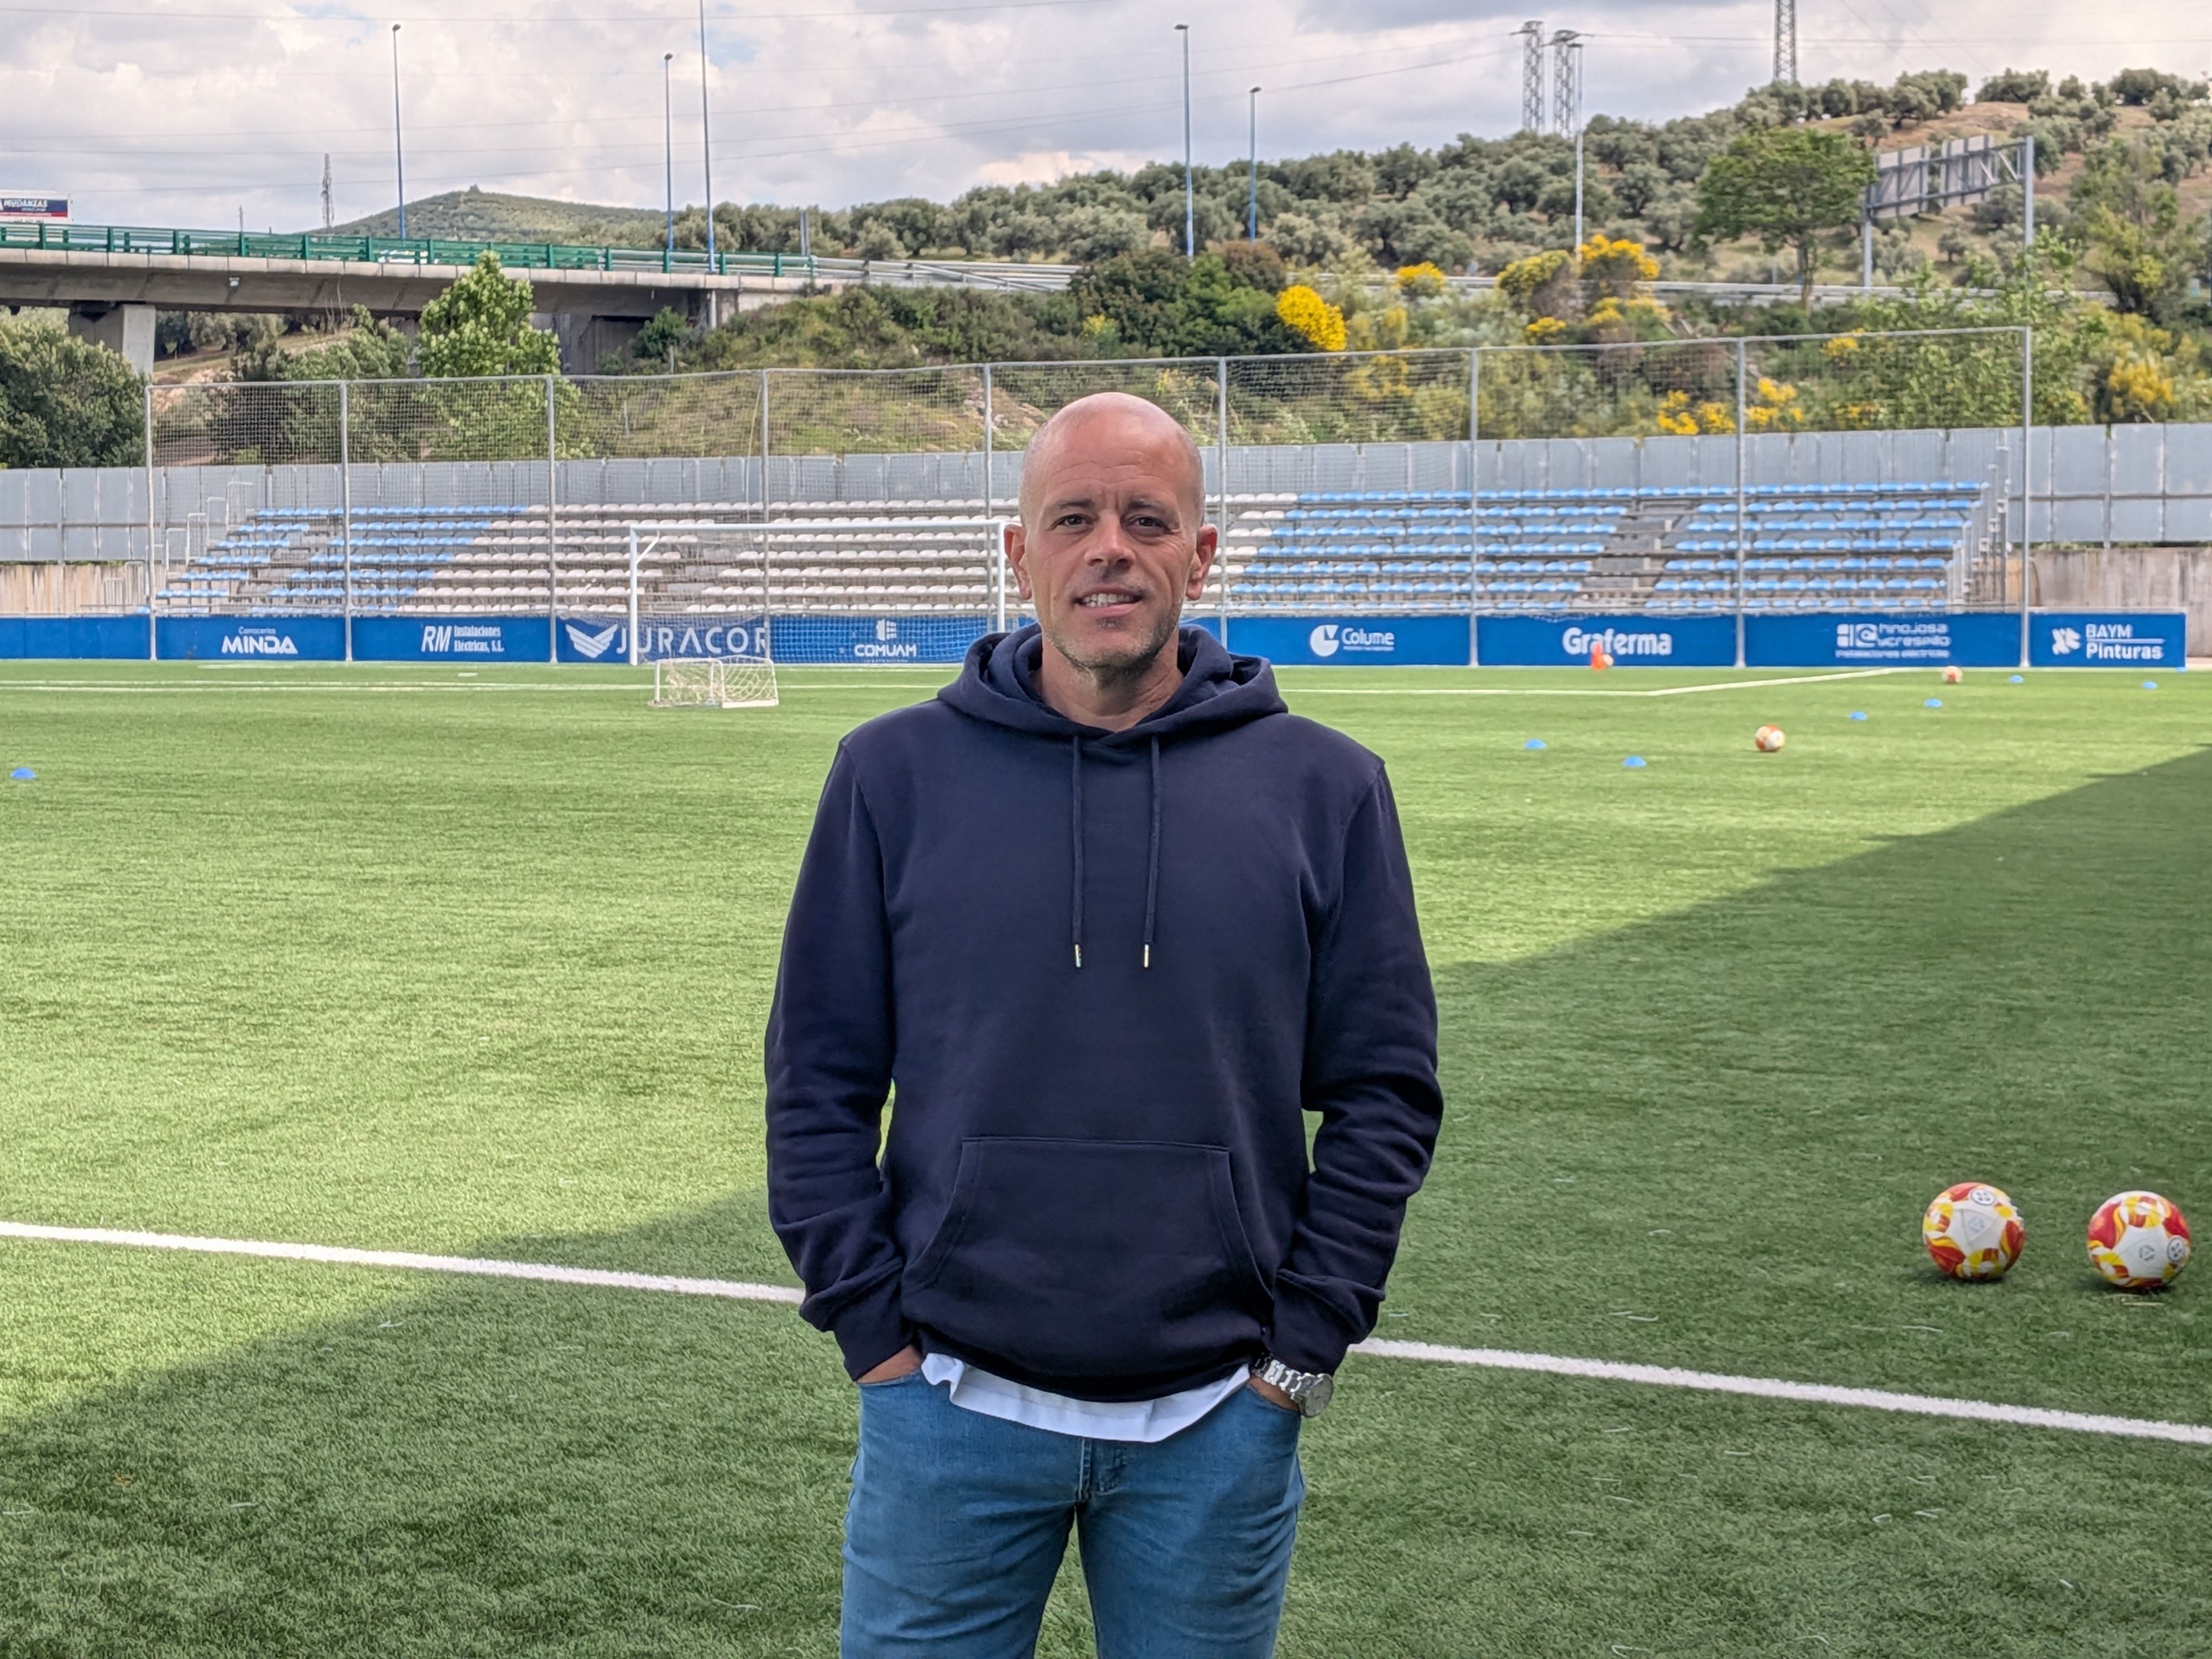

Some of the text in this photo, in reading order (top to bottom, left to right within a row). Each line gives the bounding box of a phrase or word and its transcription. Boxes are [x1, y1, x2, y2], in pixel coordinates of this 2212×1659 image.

[421, 625, 452, 652] RM
[454, 625, 501, 637] Instalaciones
[1342, 628, 1394, 645] Colume
[2086, 624, 2132, 638] BAYM
[222, 635, 298, 654] MINDA
[854, 644, 917, 657] COMUAM
[2086, 642, 2164, 660] Pinturas
